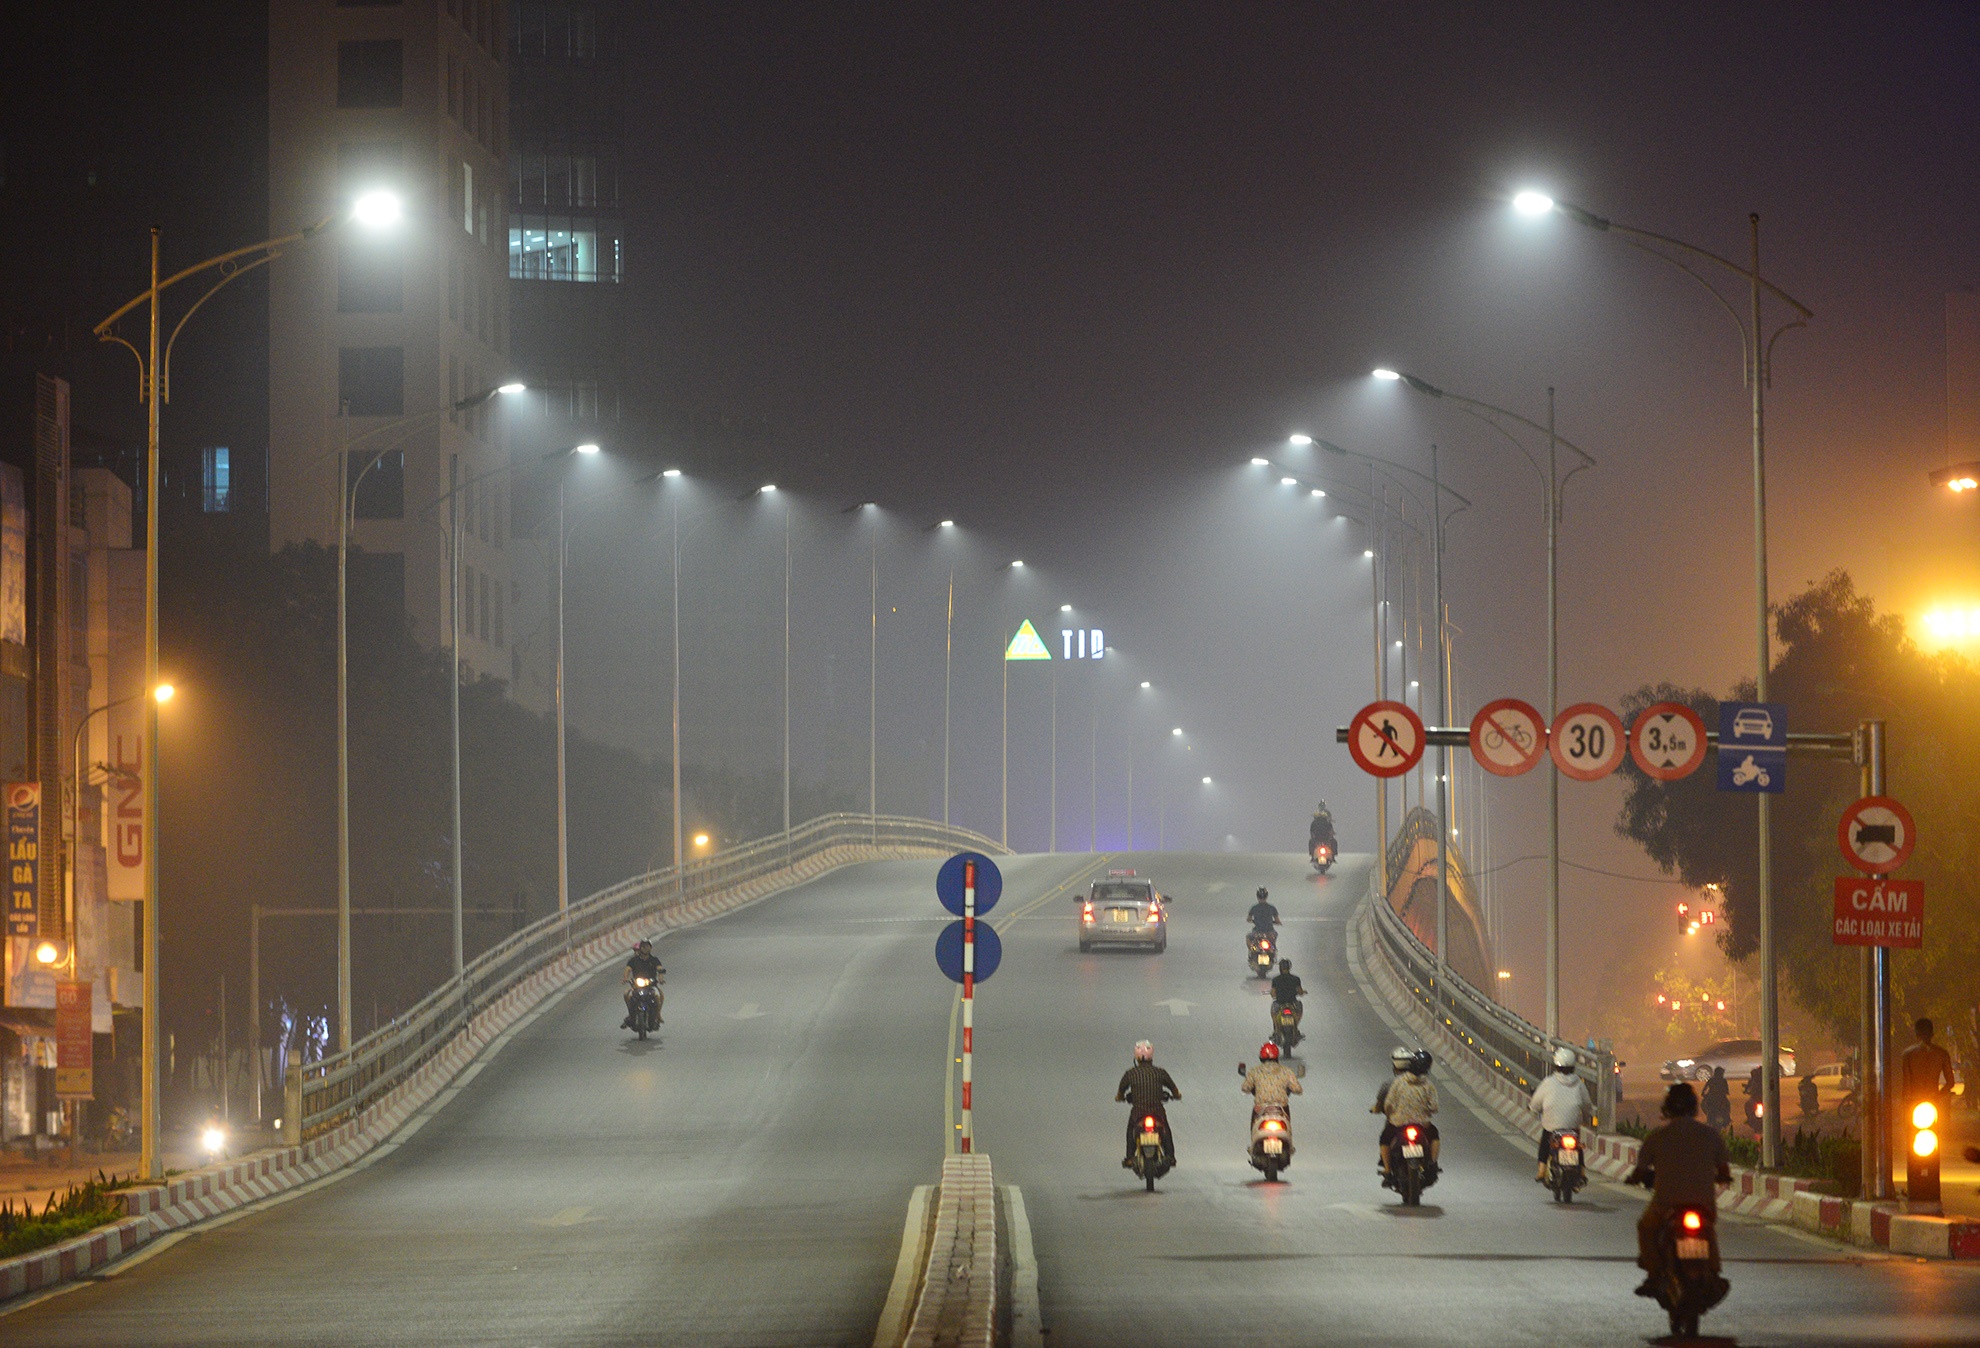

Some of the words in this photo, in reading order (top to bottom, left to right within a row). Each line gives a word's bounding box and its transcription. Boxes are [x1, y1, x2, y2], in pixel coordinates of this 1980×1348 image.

[1061, 629, 1104, 660] TID
[1569, 724, 1605, 759] 30
[116, 735, 142, 868] GNC
[13, 891, 32, 909] TA
[1852, 882, 1908, 912] CẤM
[1835, 917, 1858, 935] CÁC
[1861, 920, 1885, 939] LOẠI
[1888, 921, 1902, 937] XE
